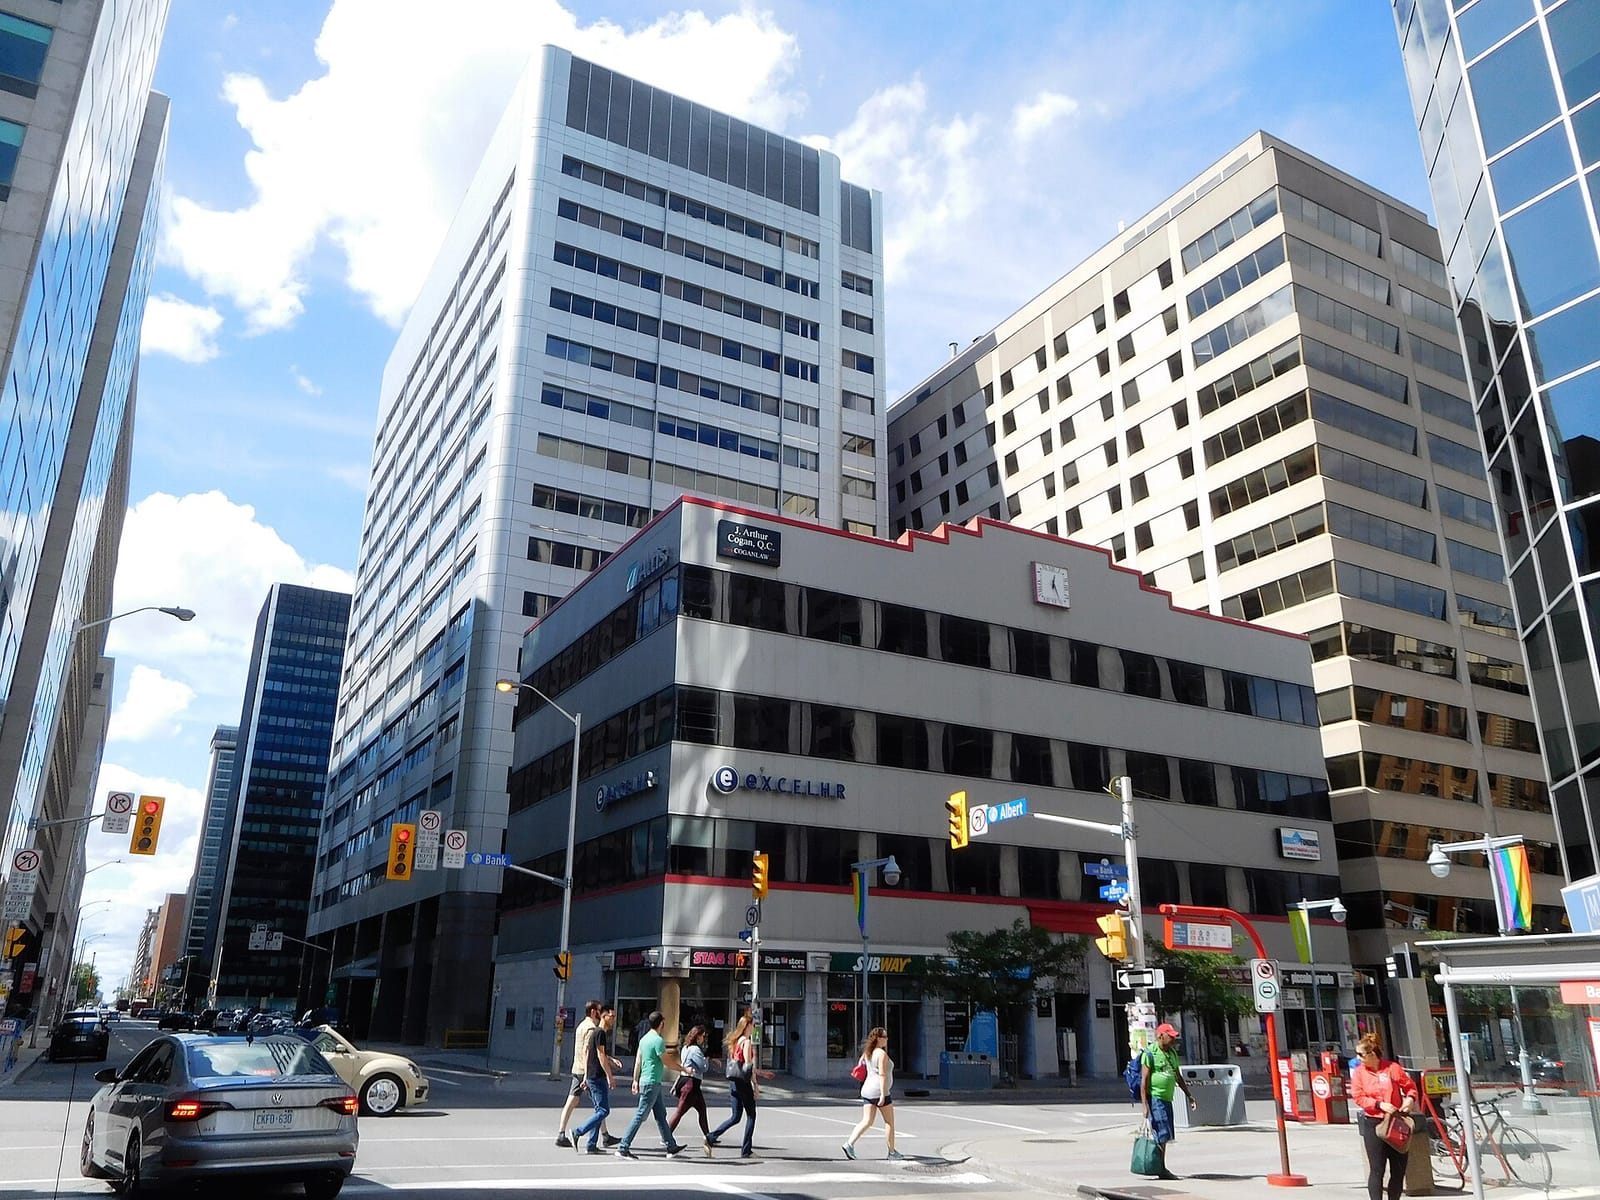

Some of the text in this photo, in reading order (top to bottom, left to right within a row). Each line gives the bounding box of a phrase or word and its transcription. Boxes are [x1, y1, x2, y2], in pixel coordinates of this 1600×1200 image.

[734, 526, 769, 541] J. Arthur
[728, 533, 776, 551] Cogan, Q.C.
[733, 547, 769, 560] COGANLAW
[1000, 801, 1024, 820] Albert
[485, 854, 507, 866] Bank
[693, 951, 725, 966] STAG
